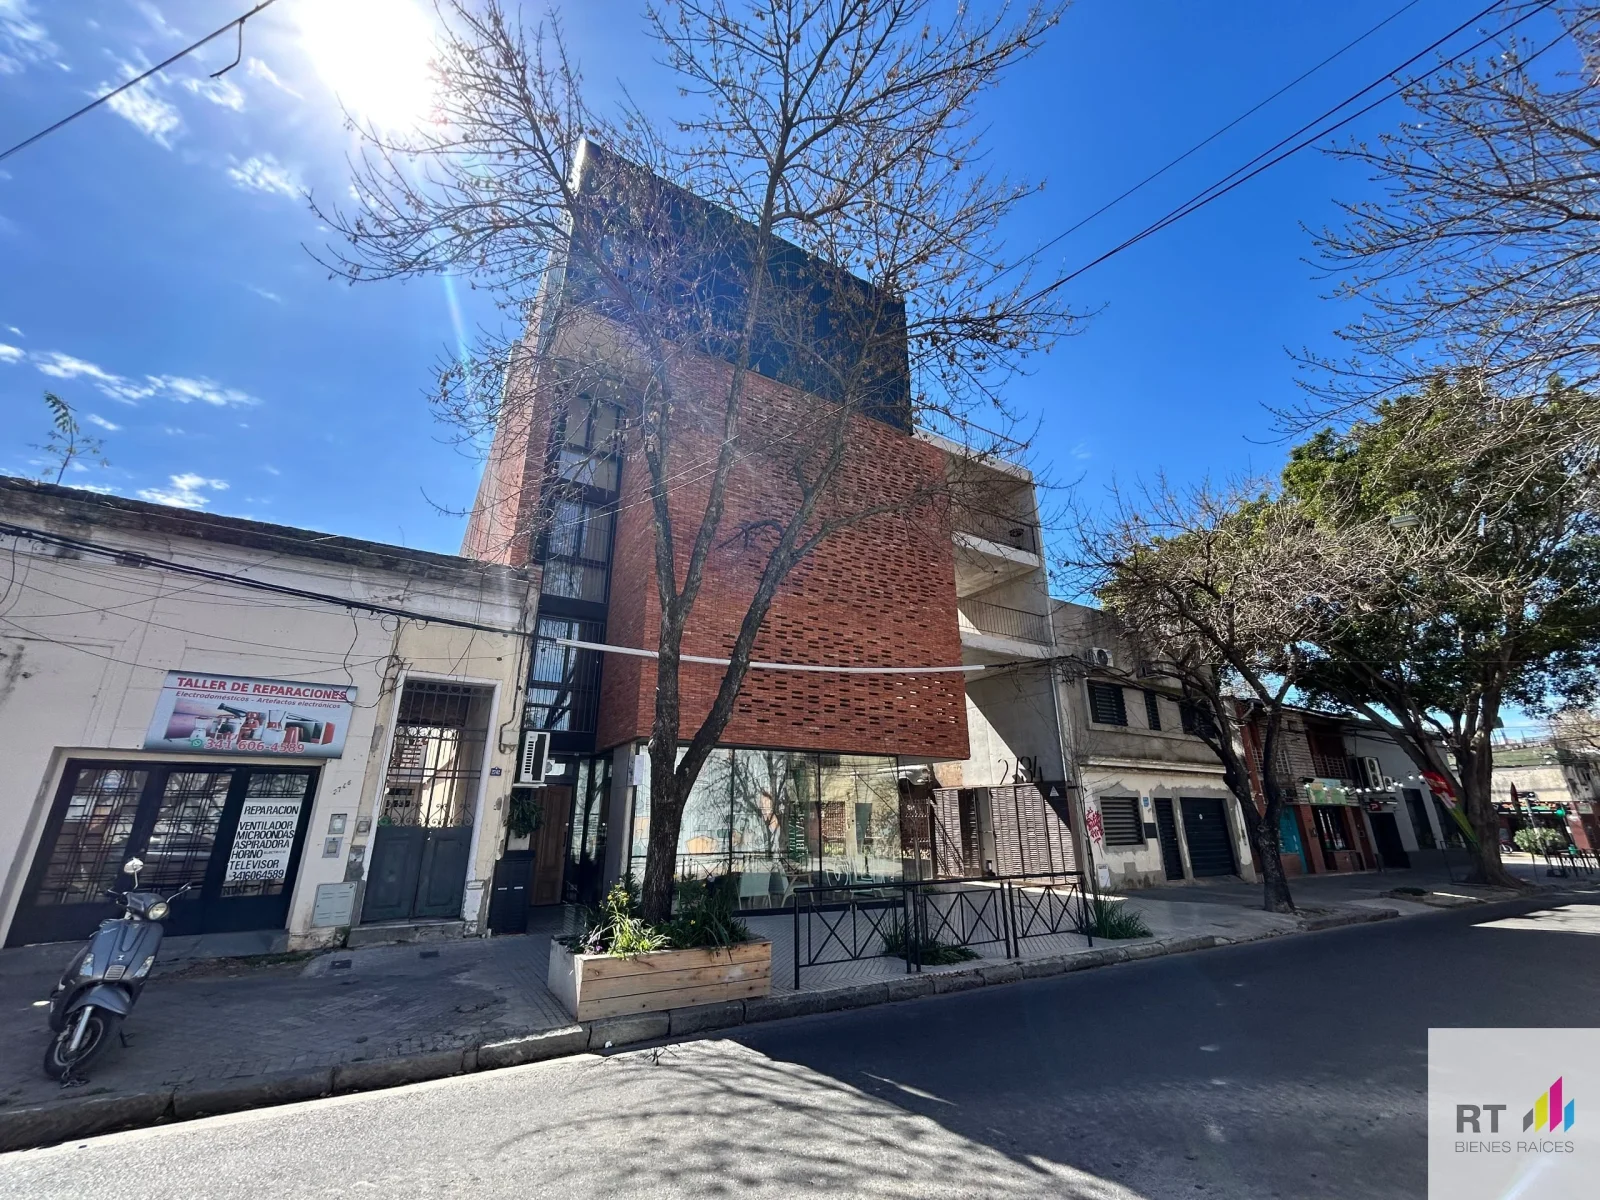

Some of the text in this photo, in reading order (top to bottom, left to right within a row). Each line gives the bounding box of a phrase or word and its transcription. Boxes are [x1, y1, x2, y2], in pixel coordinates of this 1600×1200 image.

[177, 677, 347, 700] TALLER DE REPARACIONES
[176, 690, 249, 702] Electrodomésticos
[256, 697, 296, 706] Artefactos
[297, 701, 341, 709] electrónicos
[204, 739, 304, 753] 341 606-4589
[244, 805, 299, 815] REPARACION
[239, 821, 294, 831] VENTILADOR
[236, 830, 295, 840] MICROONDAS
[233, 839, 290, 850] ASPIRADORA
[231, 849, 263, 859] HORNO
[230, 859, 280, 870] TELEVISOR
[231, 869, 284, 881] 3416064589
